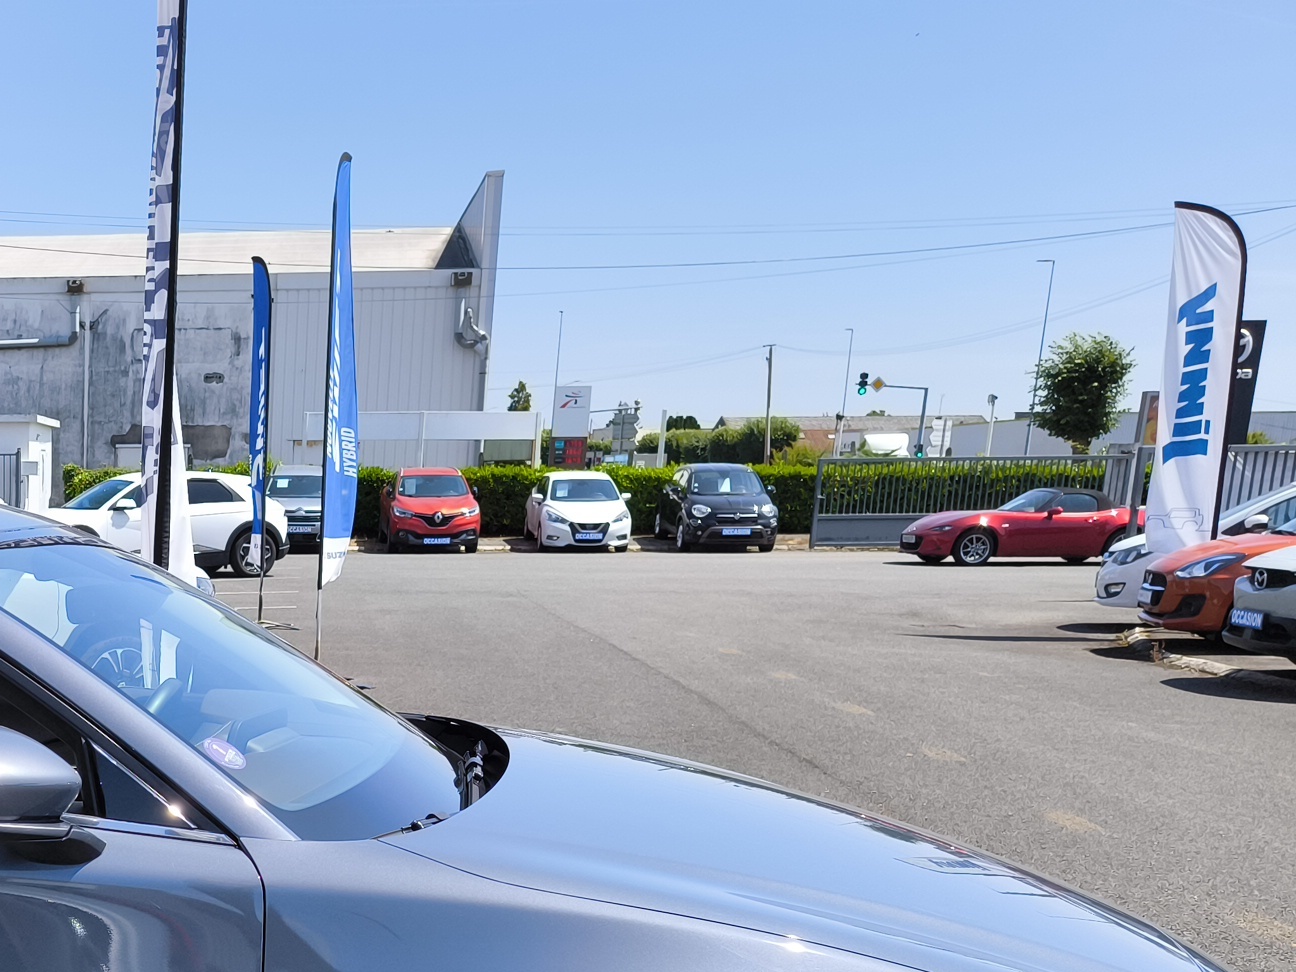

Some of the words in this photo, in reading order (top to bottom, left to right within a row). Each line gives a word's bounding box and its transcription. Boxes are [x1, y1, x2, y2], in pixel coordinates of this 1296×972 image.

[340, 426, 357, 478] HYBRID
[722, 528, 751, 536] OCCASION
[1231, 609, 1263, 628] OCCASION
